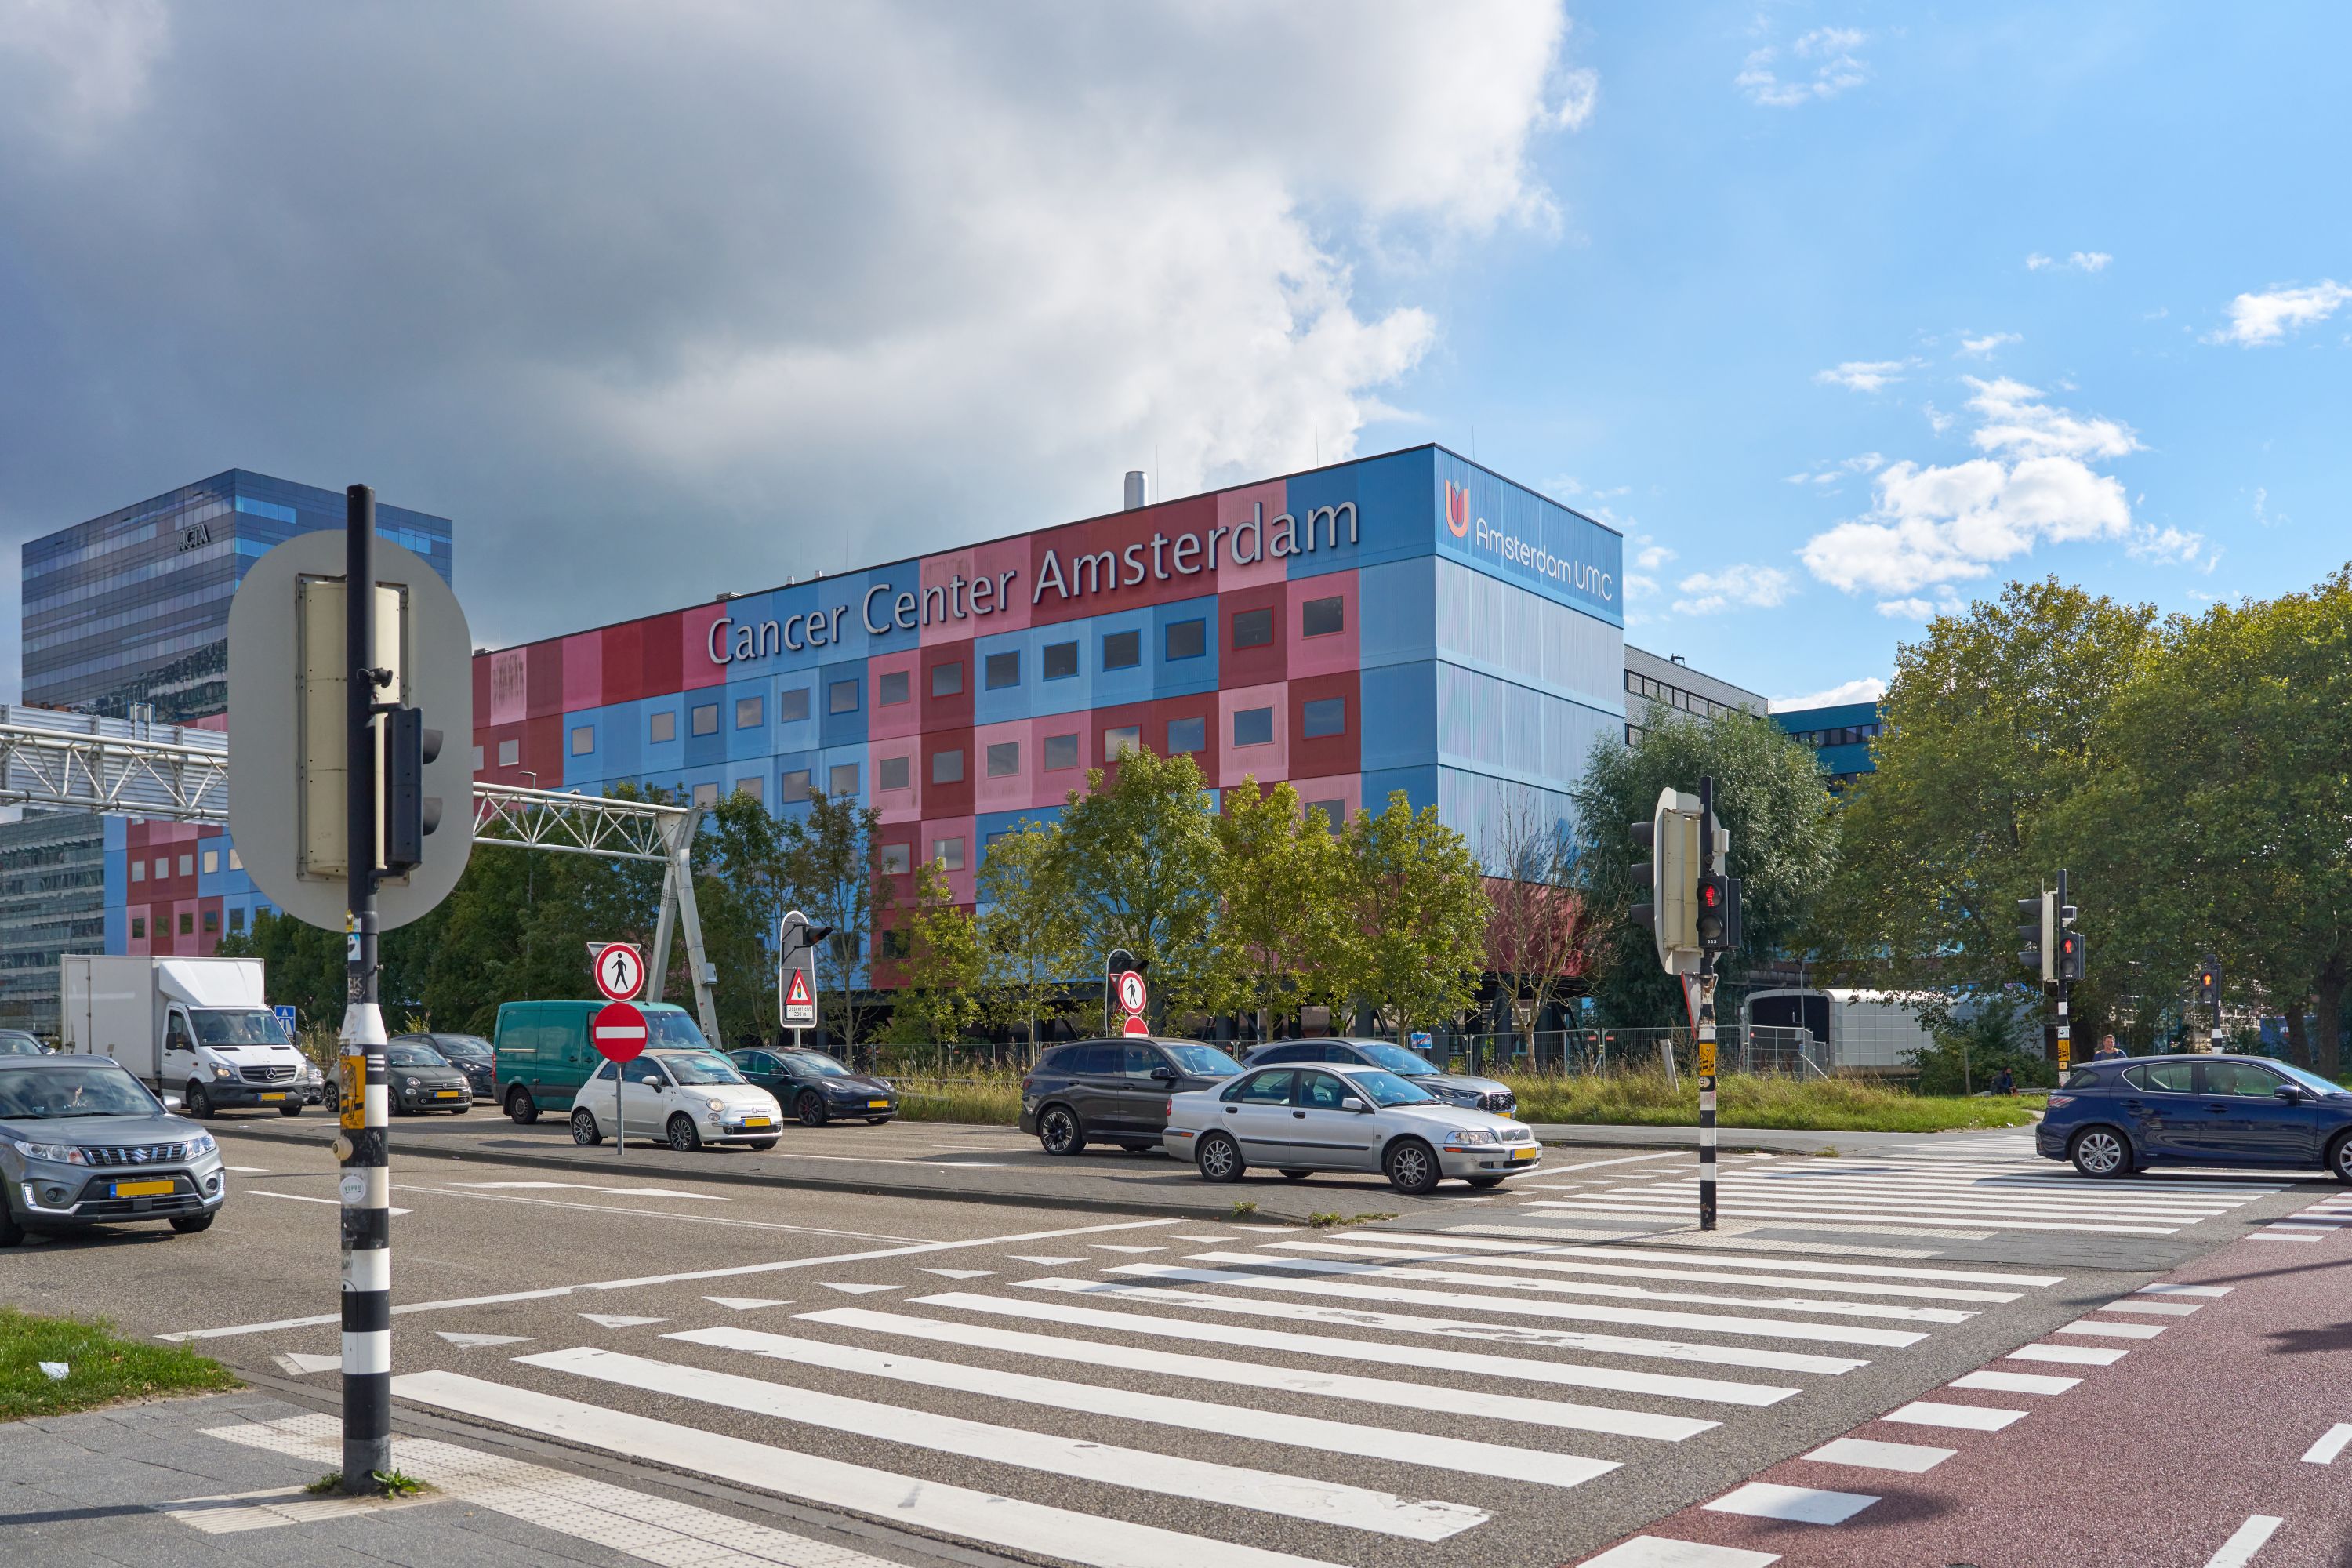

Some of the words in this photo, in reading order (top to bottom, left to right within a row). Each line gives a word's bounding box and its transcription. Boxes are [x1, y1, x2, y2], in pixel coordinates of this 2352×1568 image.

[175, 524, 210, 551] ACTA
[1476, 517, 1571, 584] Amsterdam
[1574, 560, 1612, 601] UMC
[708, 605, 848, 665] Cancer
[862, 570, 1017, 635] Center
[1033, 502, 1358, 604] Amsterdam
